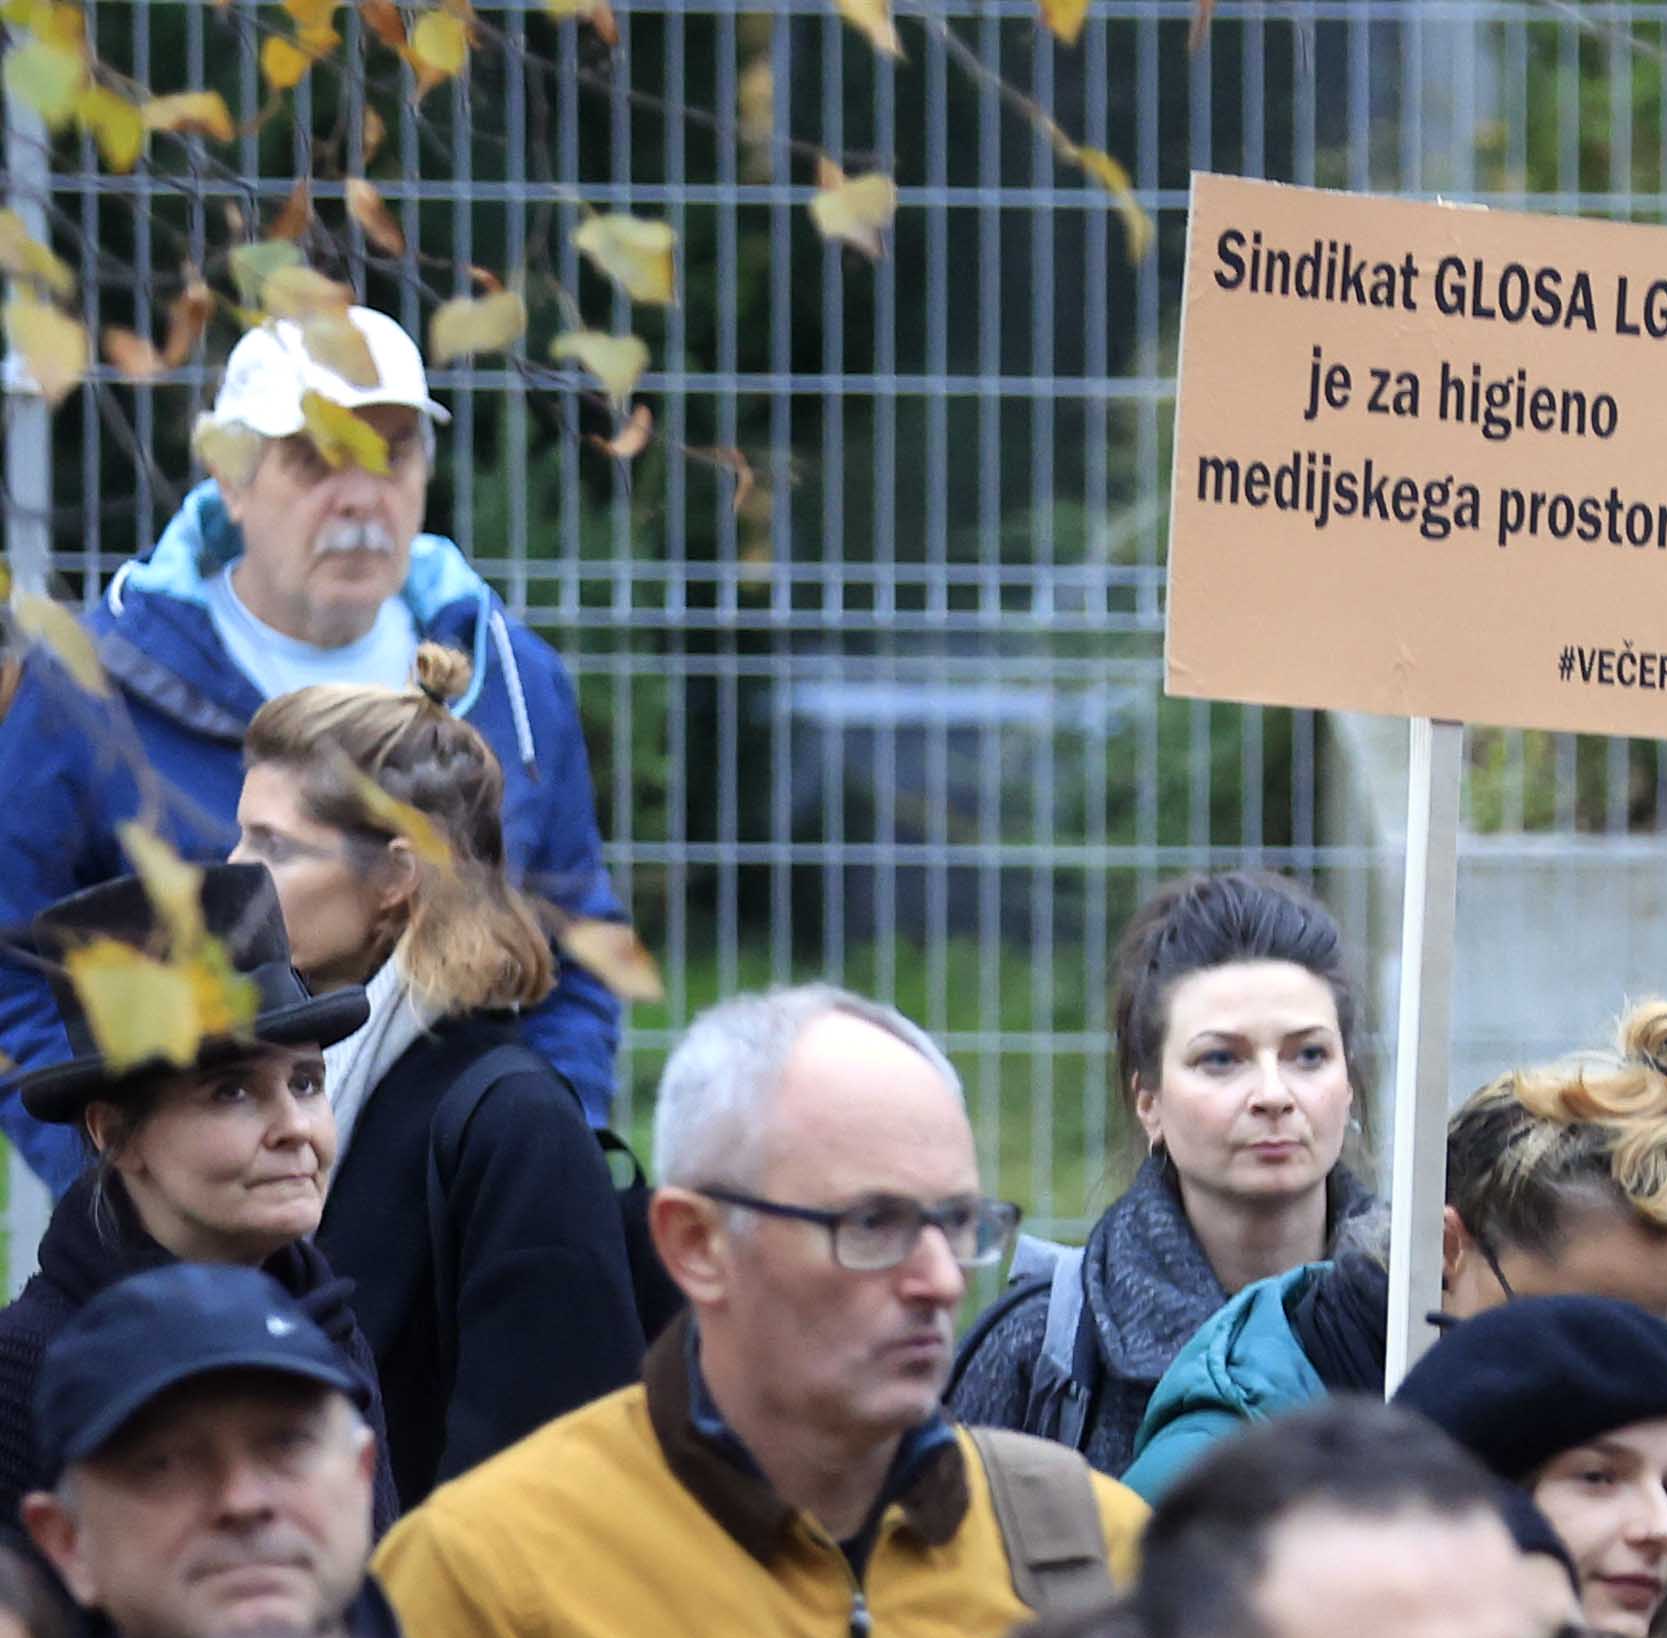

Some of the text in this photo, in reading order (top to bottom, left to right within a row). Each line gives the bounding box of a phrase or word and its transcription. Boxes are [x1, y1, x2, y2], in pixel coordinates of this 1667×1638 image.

[1213, 227, 1419, 311] Sindikat
[1434, 255, 1598, 332] GLOSA
[1303, 344, 1618, 442] je za higieno
[1197, 450, 1480, 541] medijskega
